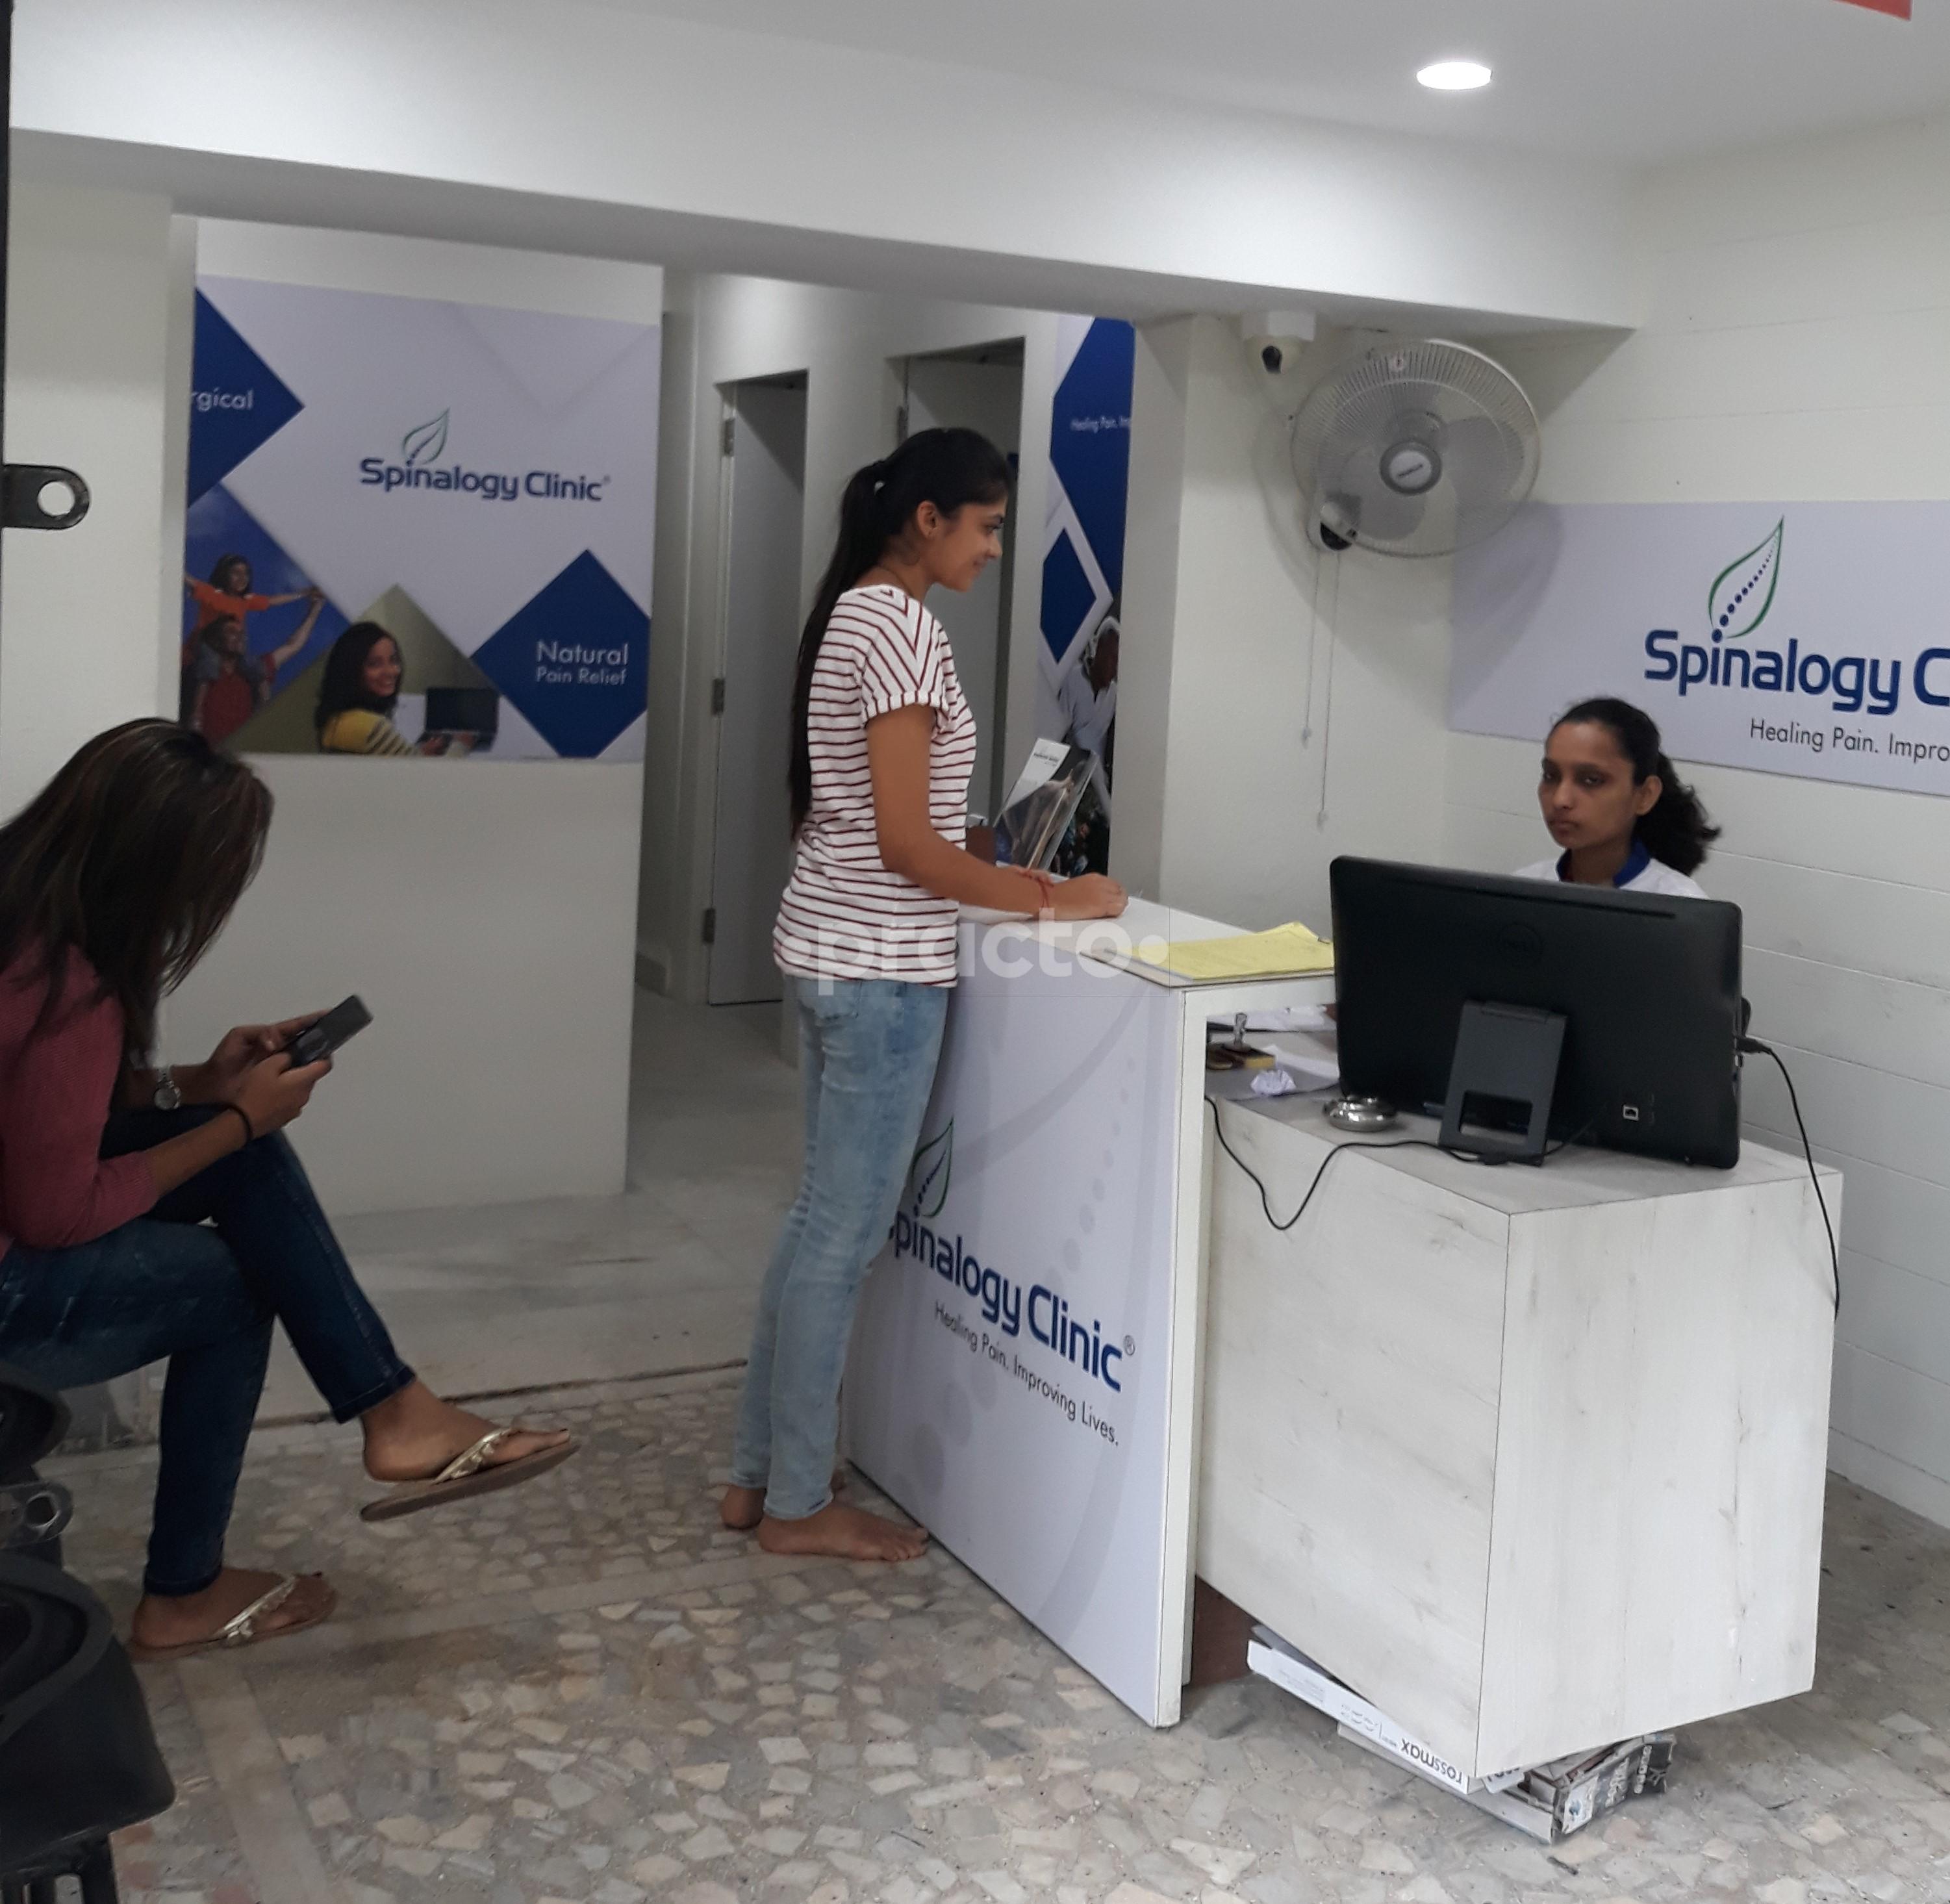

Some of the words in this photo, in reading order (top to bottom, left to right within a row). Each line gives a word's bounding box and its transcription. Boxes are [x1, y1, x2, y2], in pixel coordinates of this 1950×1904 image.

[360, 457, 518, 501] Spinalogy
[537, 639, 629, 665] Natural
[537, 666, 572, 682] Pain
[579, 668, 627, 685] Relief
[1644, 628, 1901, 716] Spinalogy
[1750, 717, 1823, 752] Healing
[1832, 726, 1879, 754] Pain.
[889, 1204, 1021, 1336] pinalogy
[934, 1301, 978, 1352] Healing
[981, 1330, 1009, 1371] Pain.
[1013, 1355, 1076, 1421] Improving
[1082, 1404, 1120, 1446] Lives.
[1400, 1736, 1463, 1788] rossmax
